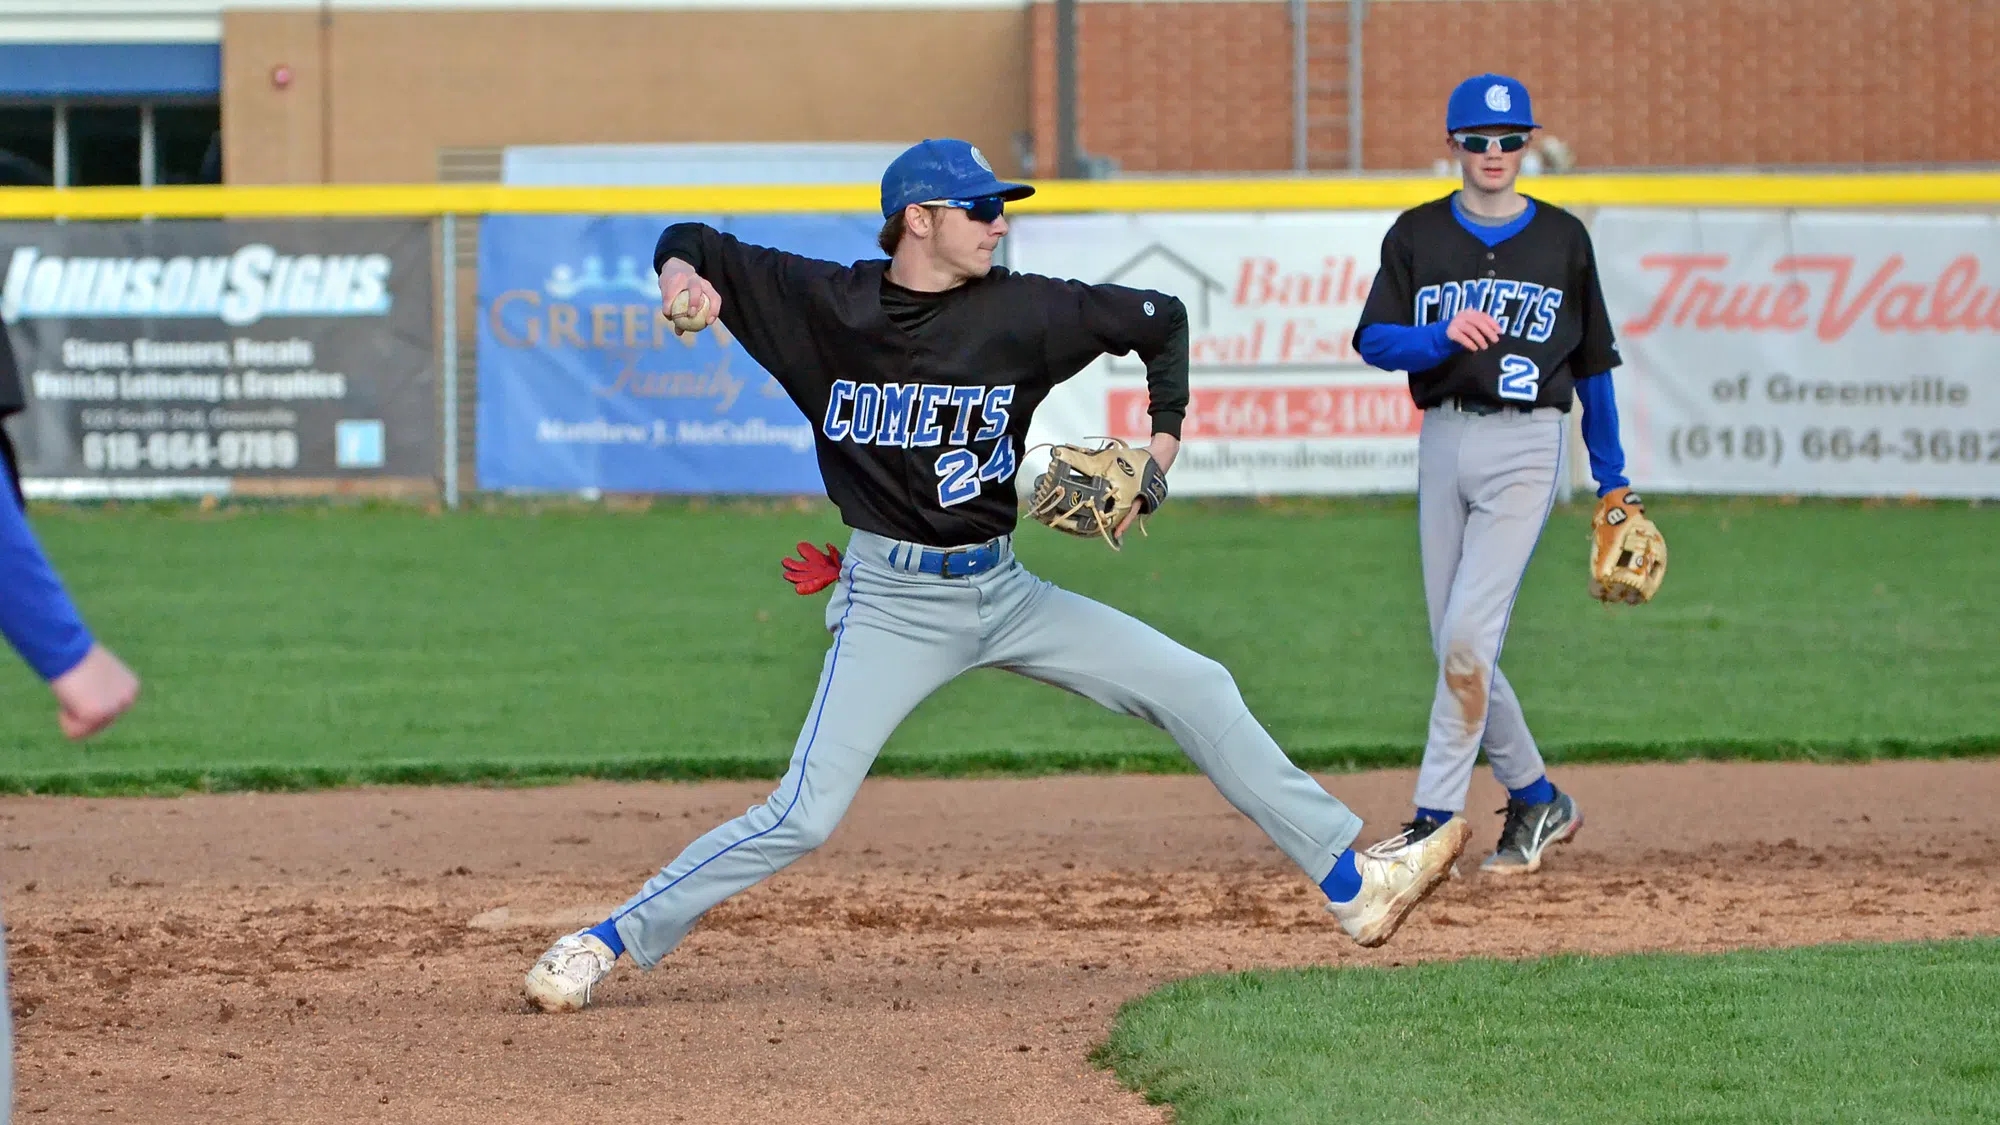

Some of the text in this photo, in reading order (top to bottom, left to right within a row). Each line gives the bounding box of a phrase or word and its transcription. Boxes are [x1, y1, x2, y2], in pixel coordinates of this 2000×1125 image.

[1232, 256, 1372, 307] Baile
[490, 289, 732, 349] GREEN
[1414, 277, 1563, 343] COMETS
[1189, 318, 1265, 365] eal
[120, 371, 222, 403] Lettering
[223, 373, 240, 399] &
[241, 370, 347, 401] Graphics
[1498, 353, 1539, 402] 2
[1711, 372, 1970, 405] of Greenville
[676, 417, 813, 453] McCulloug
[823, 379, 1015, 446] COMETS
[1668, 424, 2000, 465] (618) 664-3682
[934, 435, 1016, 508] 24
